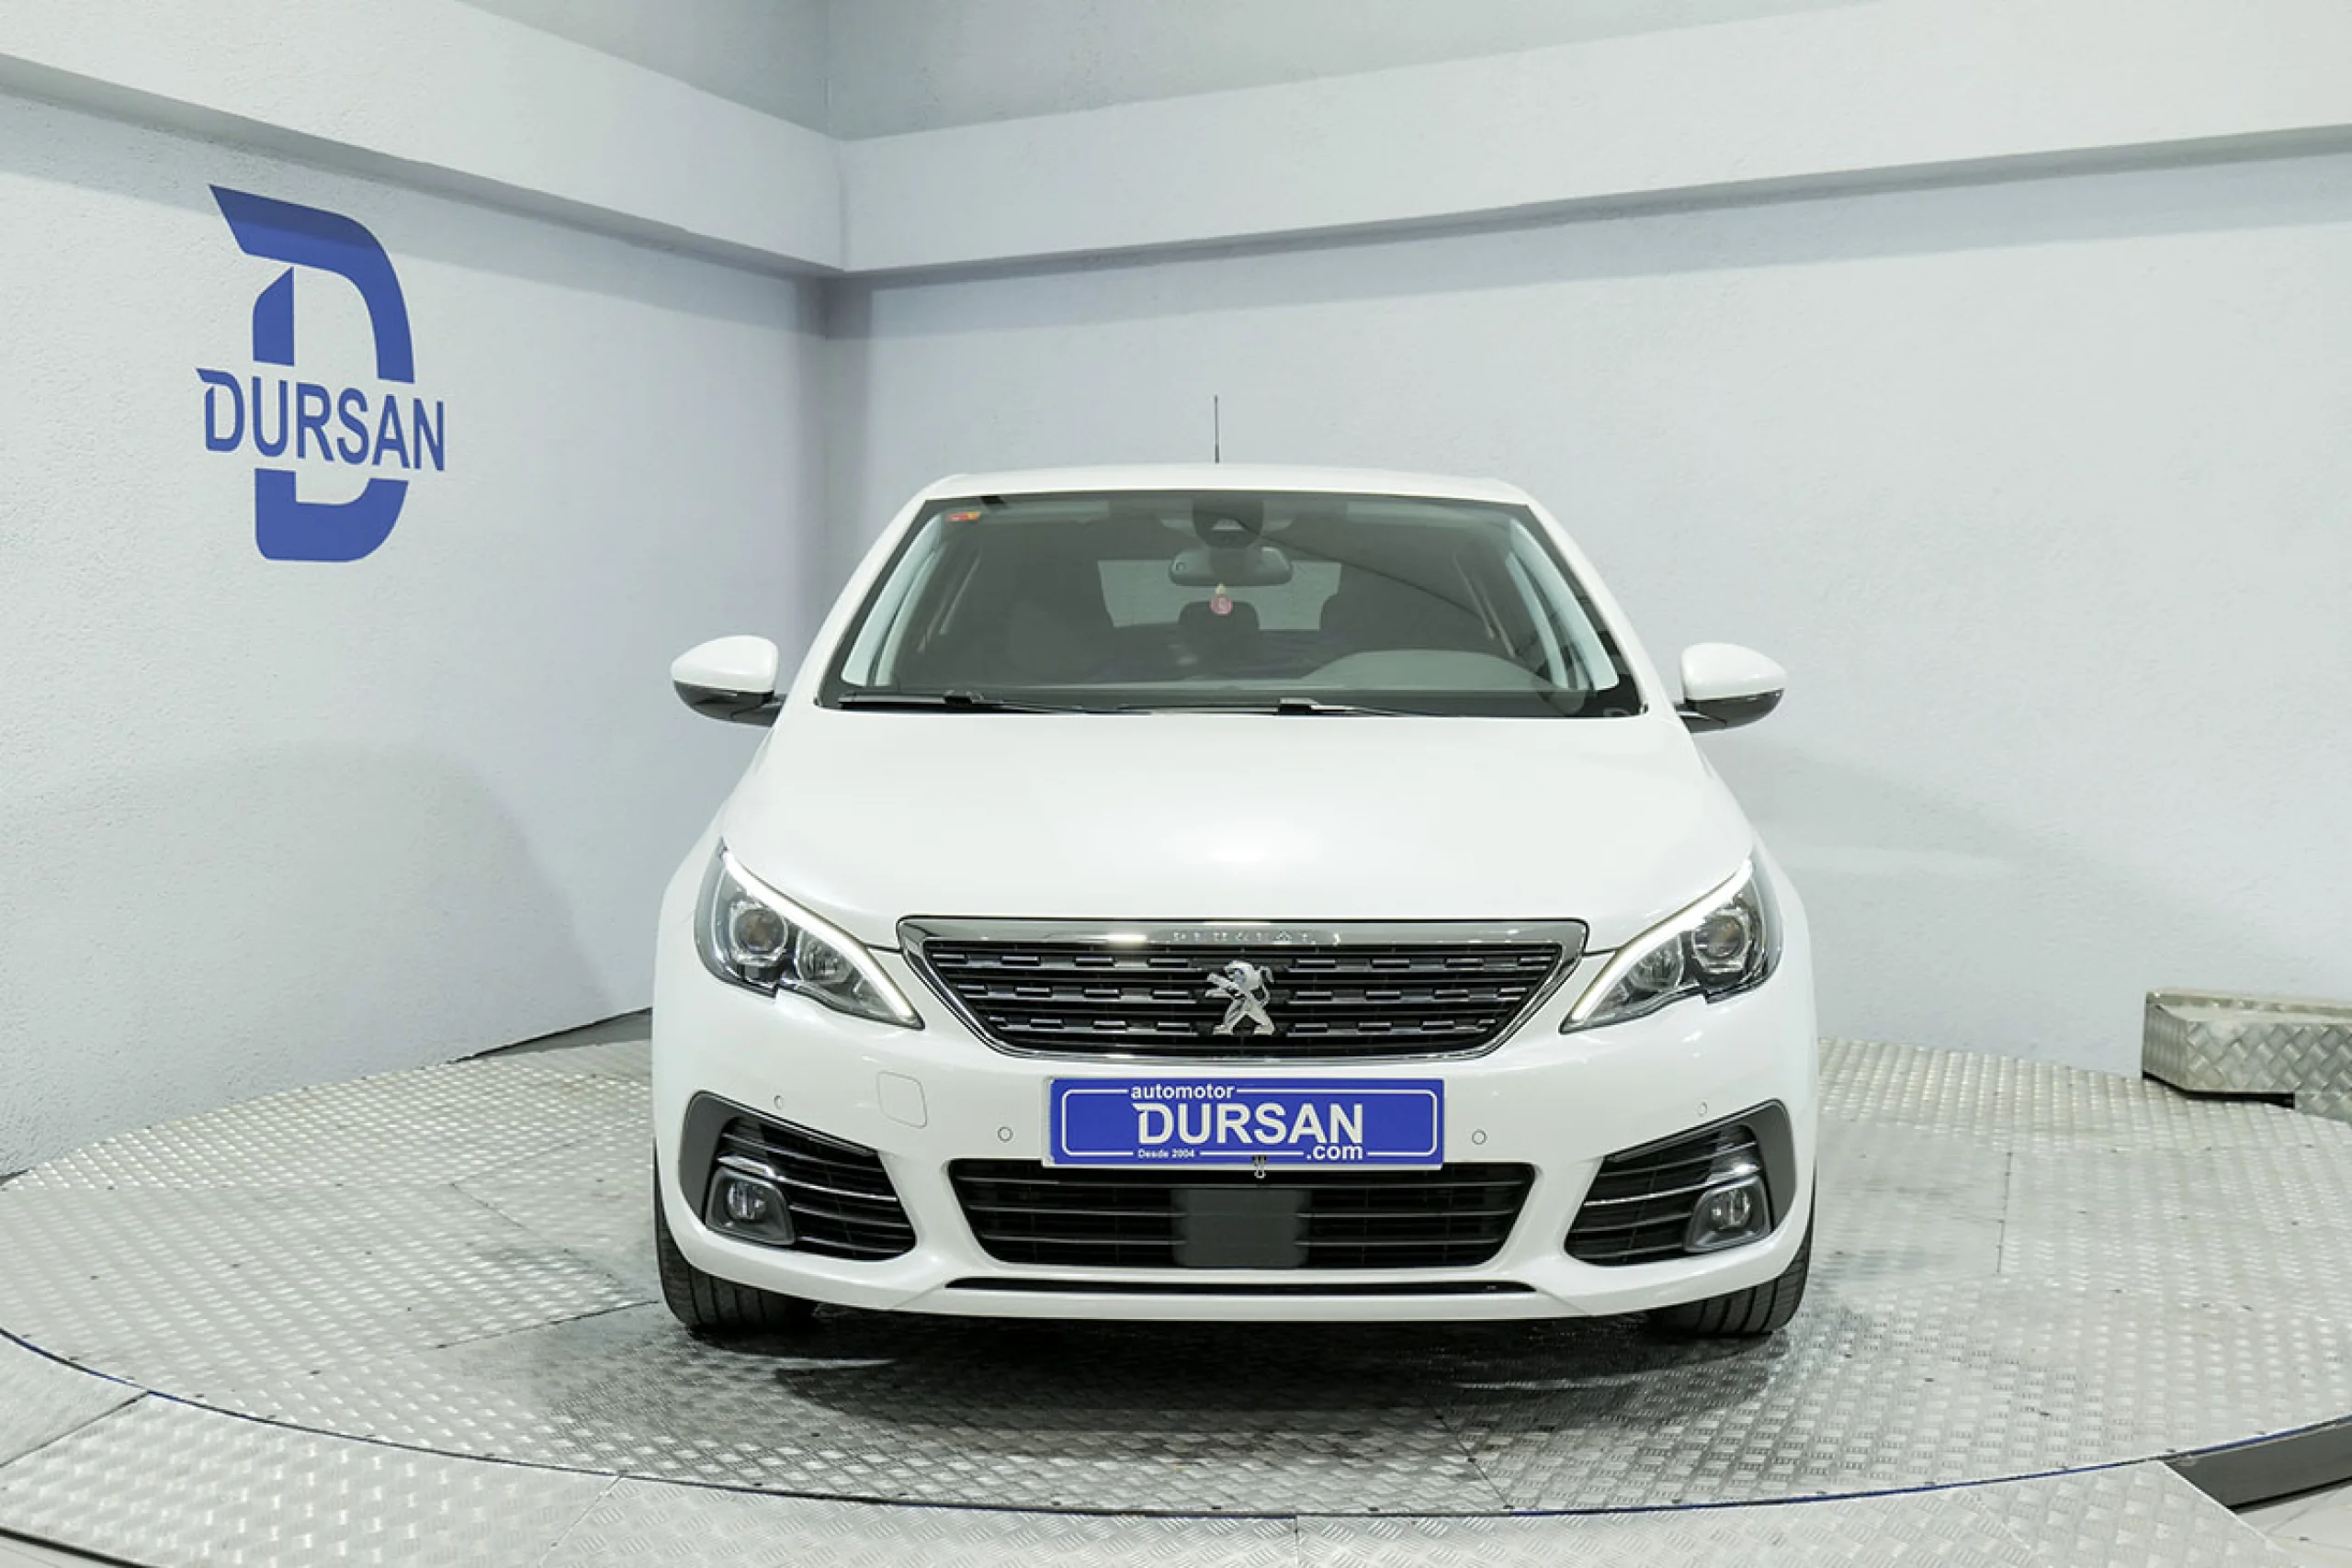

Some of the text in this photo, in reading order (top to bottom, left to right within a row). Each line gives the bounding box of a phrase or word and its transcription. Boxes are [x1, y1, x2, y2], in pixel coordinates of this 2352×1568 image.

[196, 368, 445, 471] DURSAN
[1131, 1083, 1235, 1100] automotor
[1132, 1102, 1363, 1145] DURSAN
[1138, 1148, 1194, 1158] Desde 2004
[1306, 1144, 1363, 1160] .com
